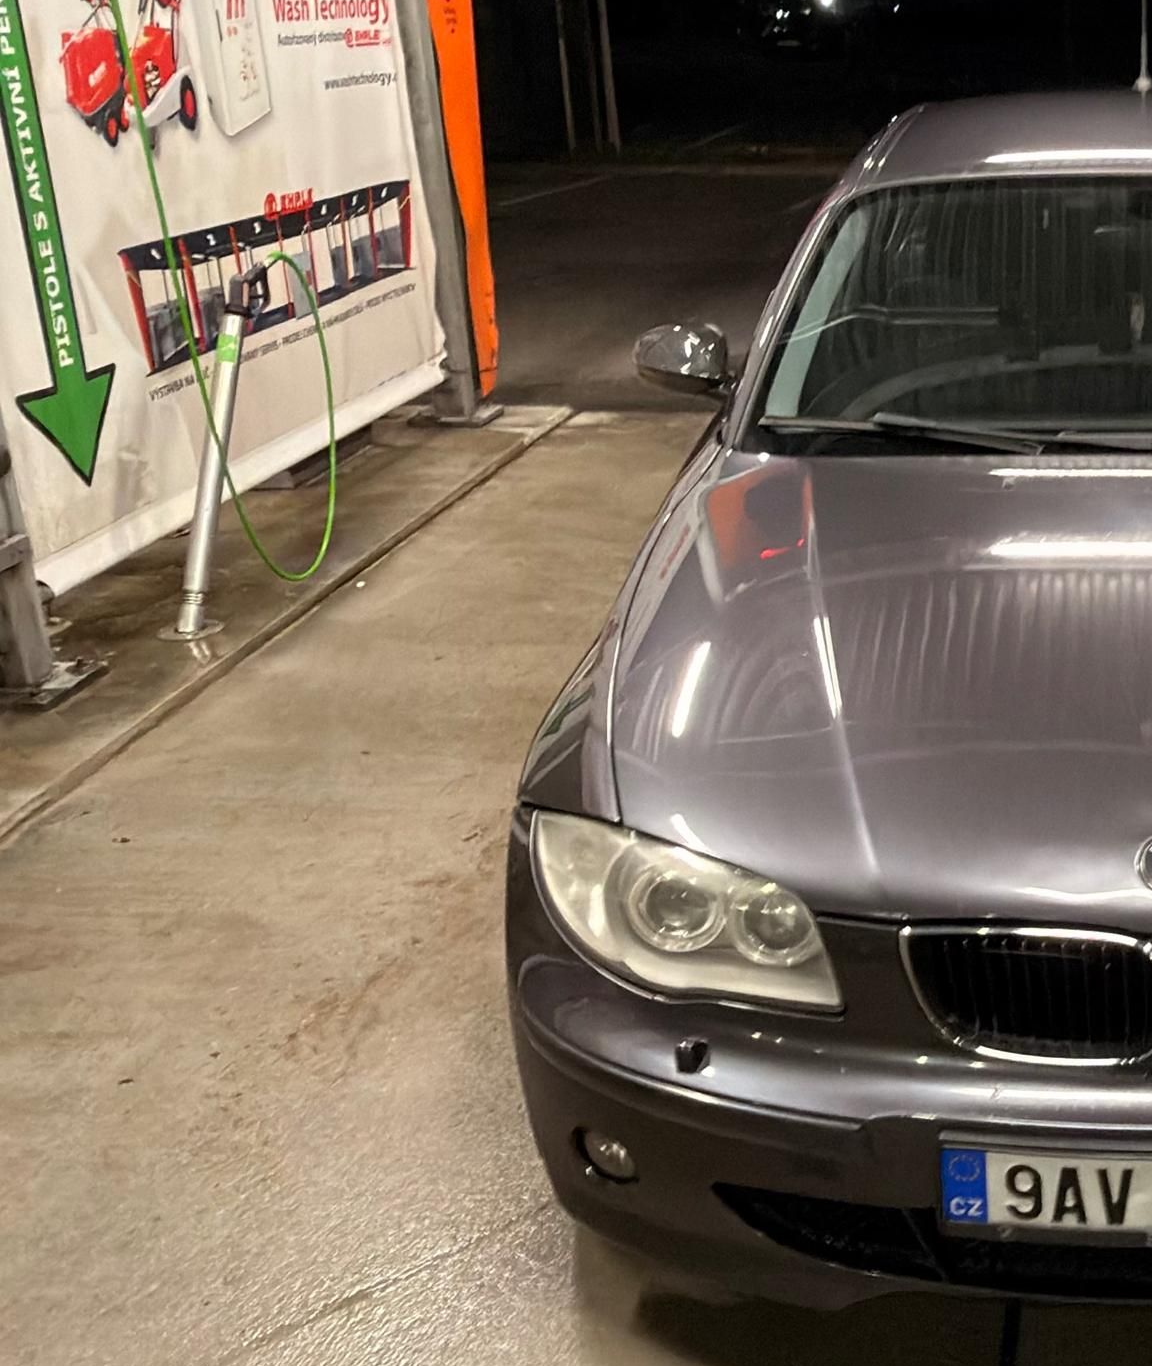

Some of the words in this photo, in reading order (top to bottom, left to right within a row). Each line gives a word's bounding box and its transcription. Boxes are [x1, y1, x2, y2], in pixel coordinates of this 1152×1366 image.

[2, 65, 44, 203] AKTIVNÍ
[33, 211, 49, 232] S
[38, 238, 75, 368] PISTOLE
[948, 1197, 984, 1217] CZ
[1004, 1163, 1134, 1225] 9AV
